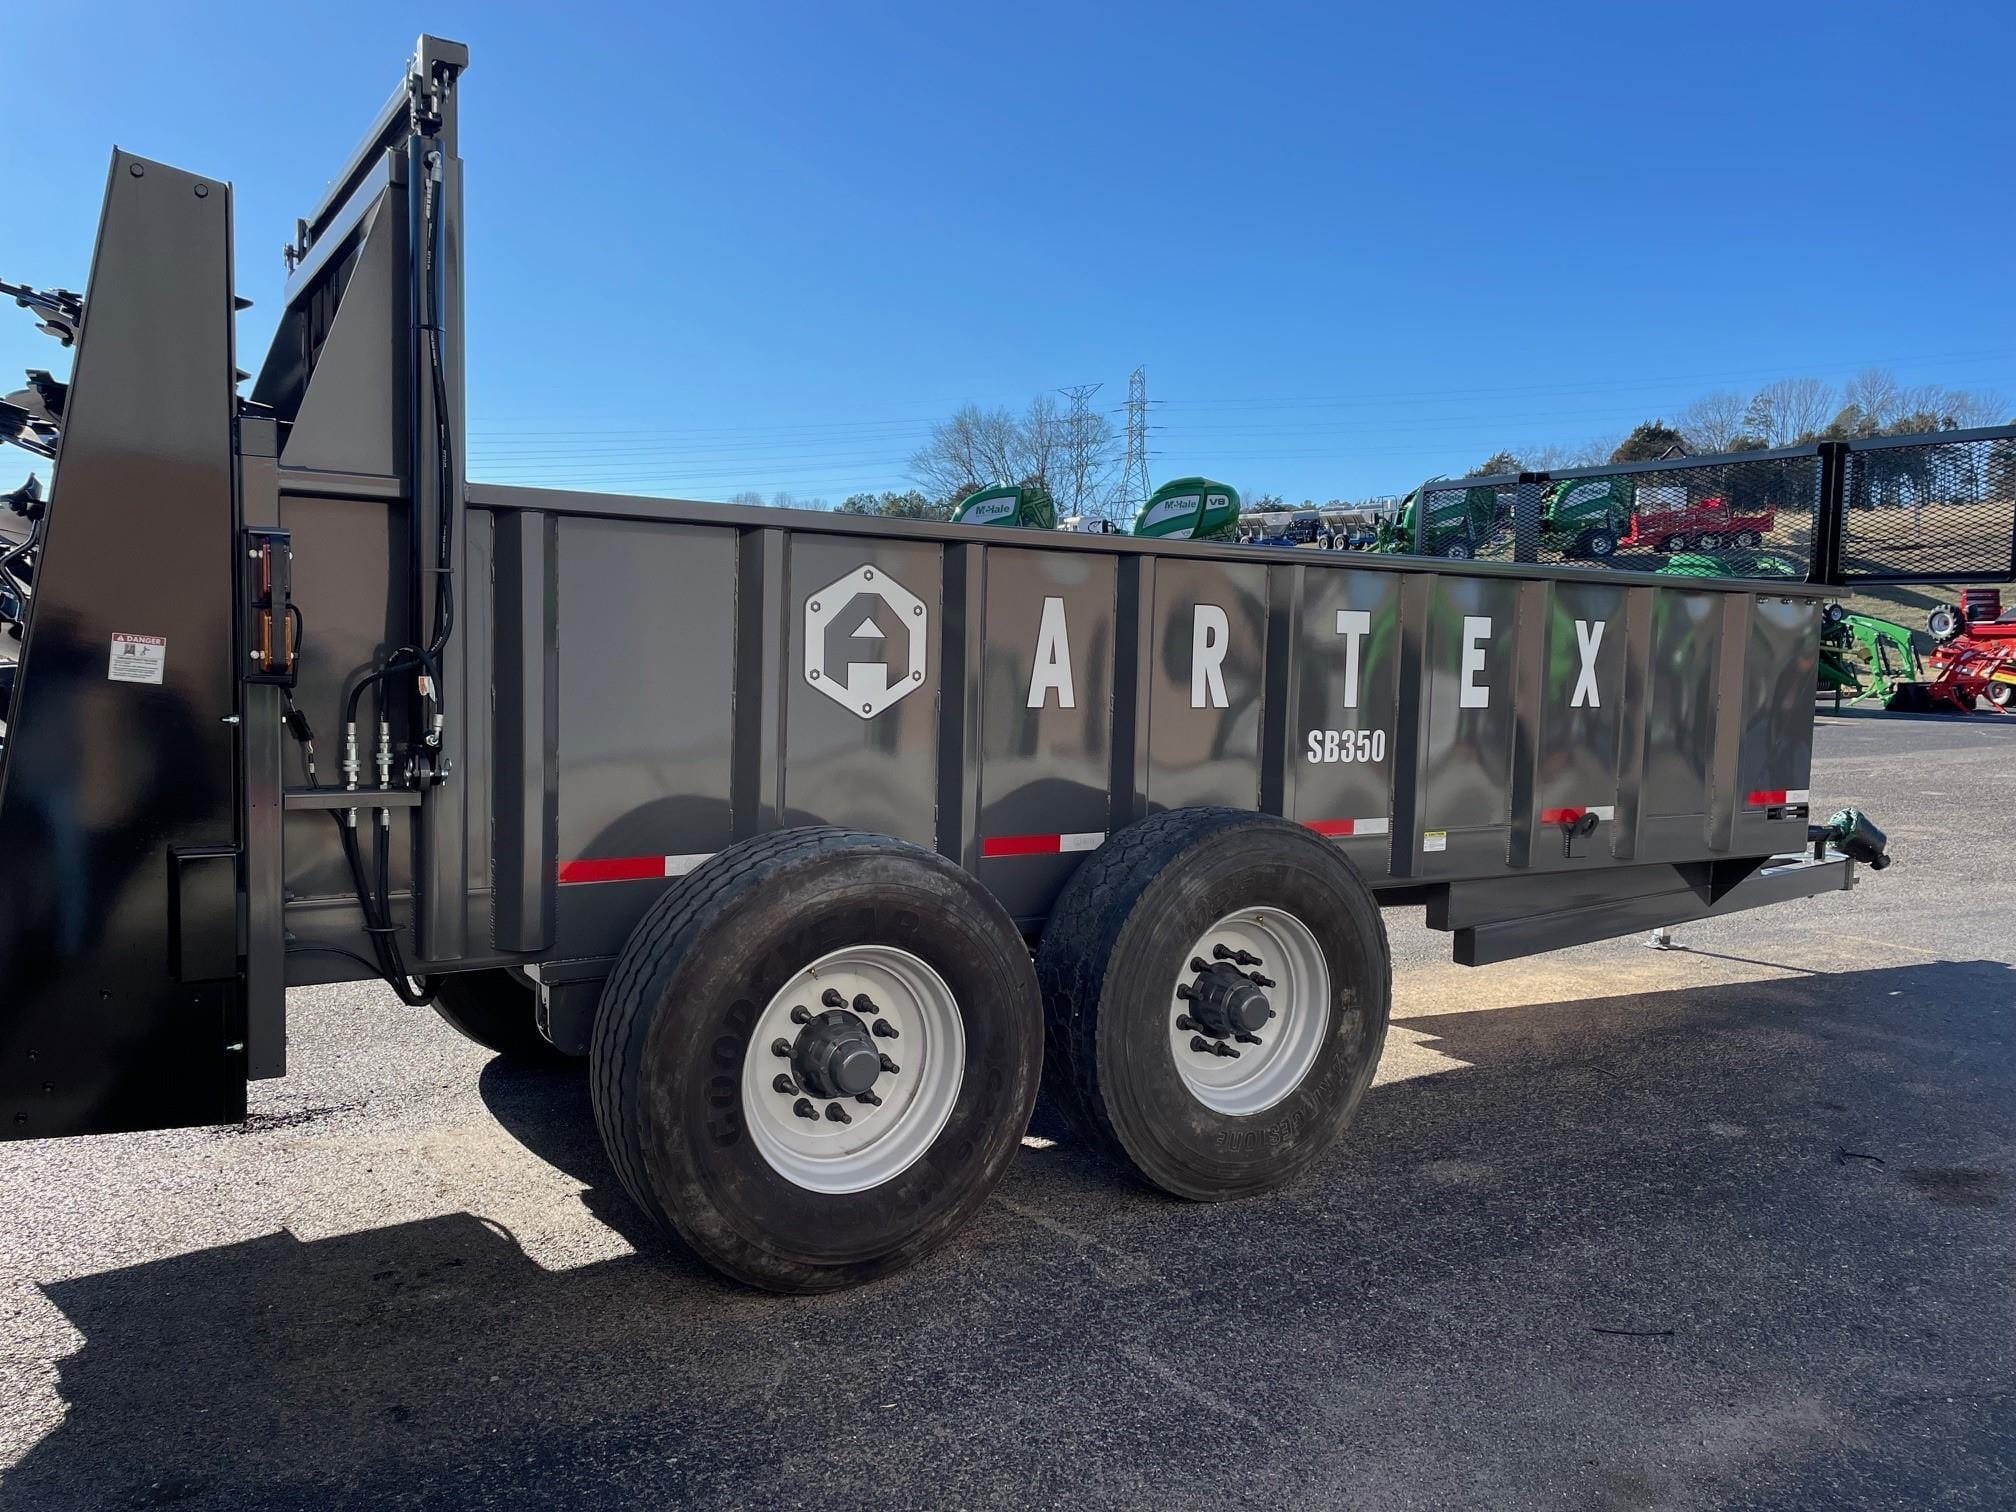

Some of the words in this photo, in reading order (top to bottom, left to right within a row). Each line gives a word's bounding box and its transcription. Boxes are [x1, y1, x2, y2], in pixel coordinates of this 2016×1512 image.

[1208, 498, 1226, 506] V8
[126, 635, 161, 645] DANGER
[1307, 730, 1385, 763] SB350
